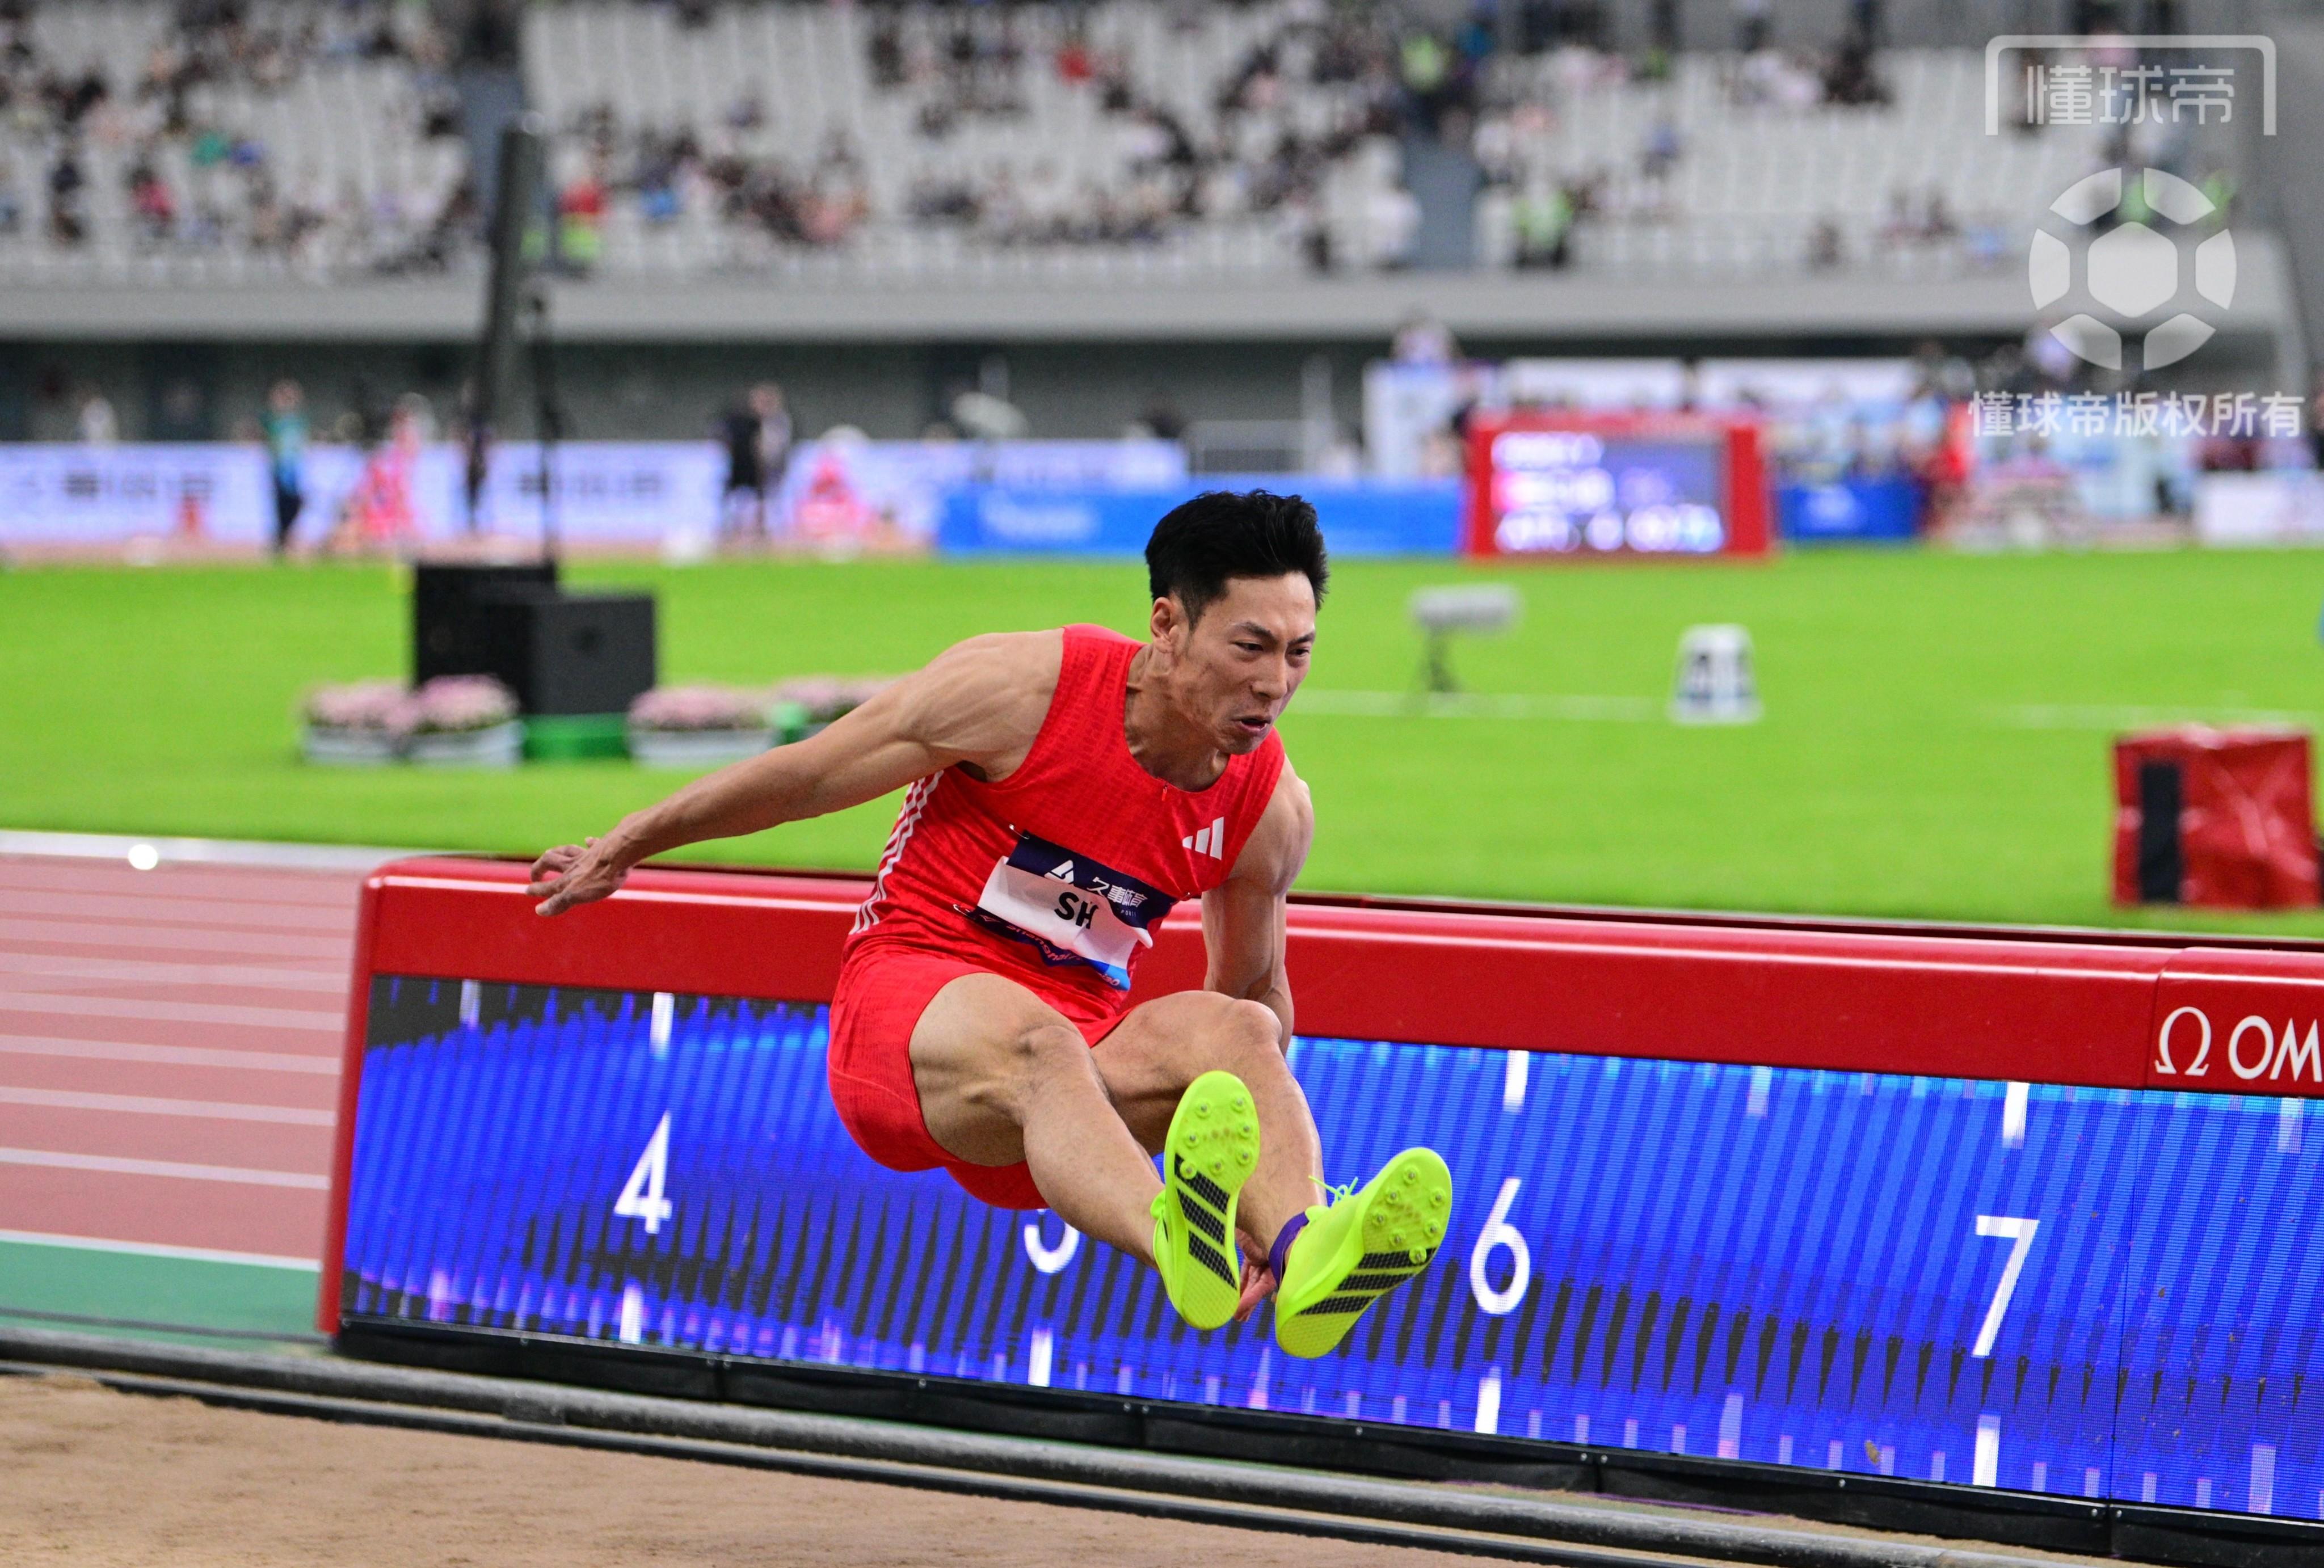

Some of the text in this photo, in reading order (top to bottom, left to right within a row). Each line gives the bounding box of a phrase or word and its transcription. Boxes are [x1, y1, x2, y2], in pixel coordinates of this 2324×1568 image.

[1054, 892, 1098, 929] SH
[614, 1110, 673, 1234] 4
[1470, 1178, 1530, 1314] 6
[1971, 1215, 2040, 1358] 7
